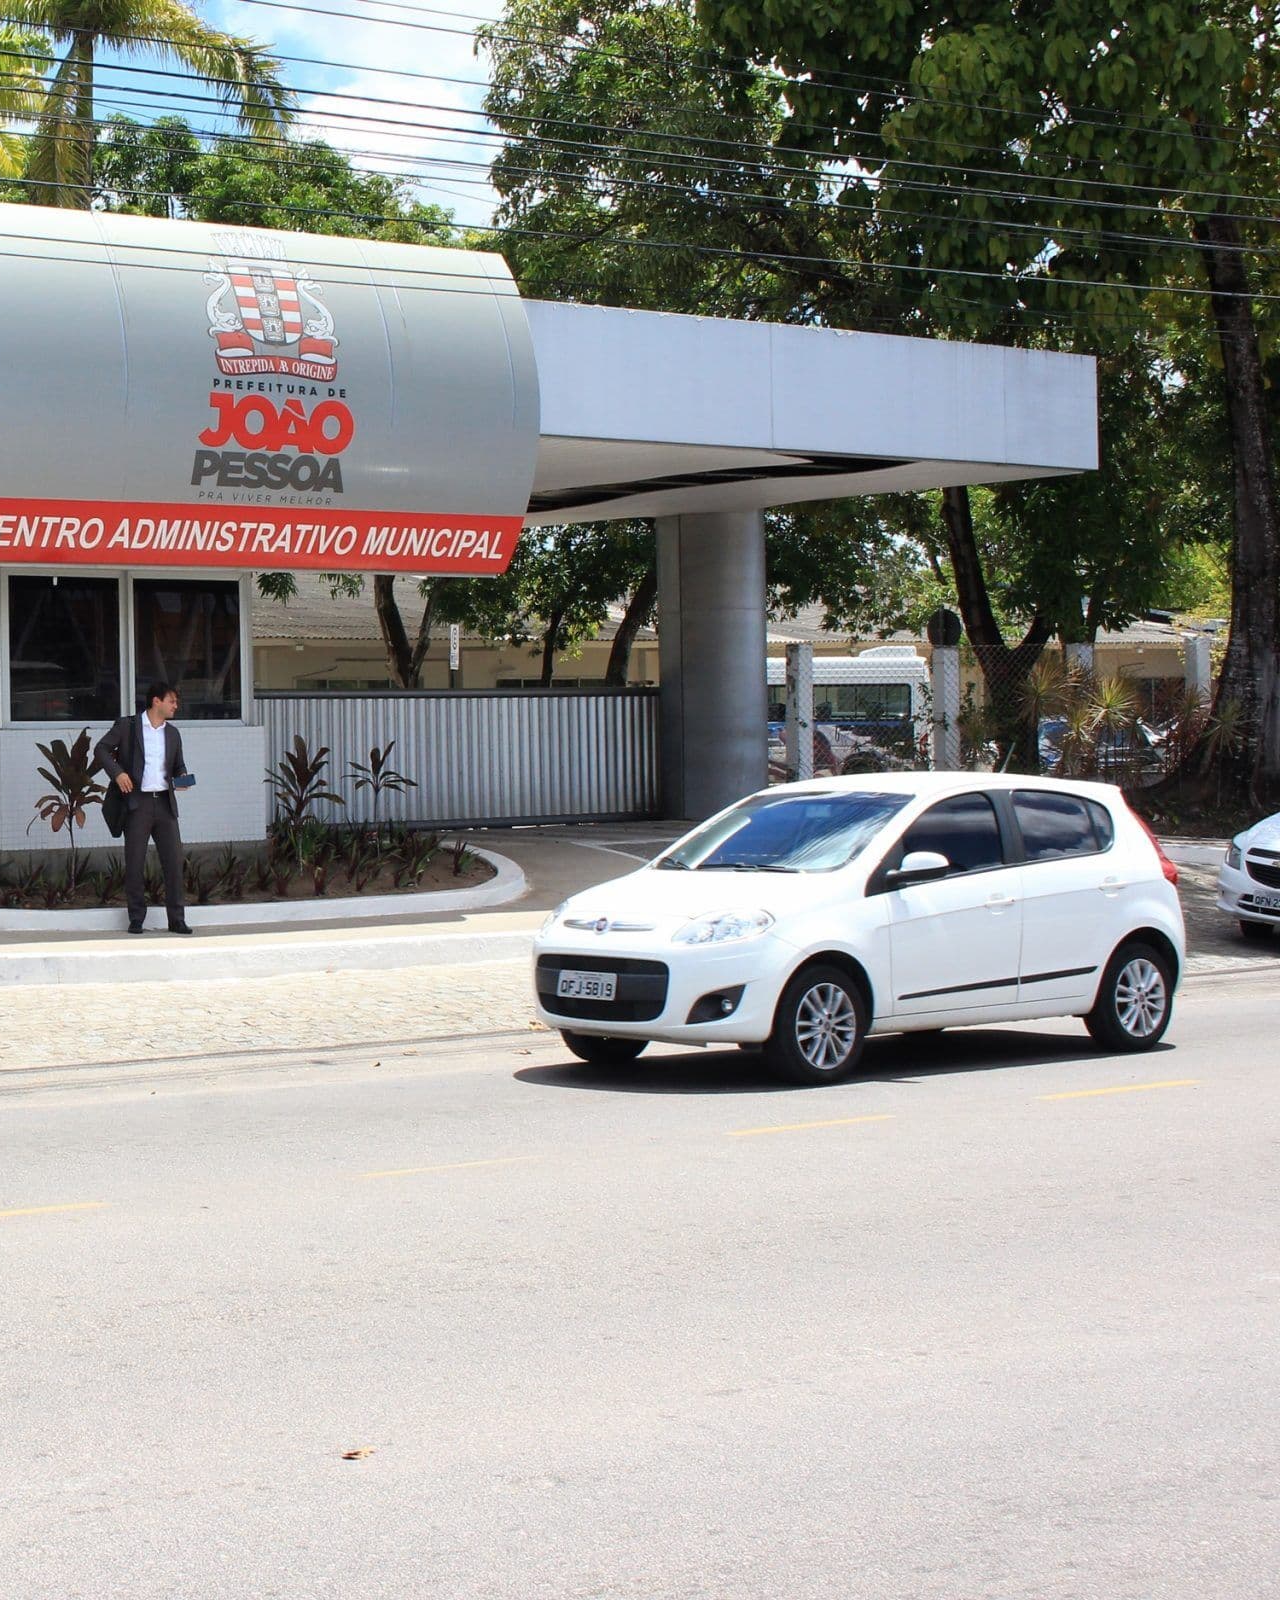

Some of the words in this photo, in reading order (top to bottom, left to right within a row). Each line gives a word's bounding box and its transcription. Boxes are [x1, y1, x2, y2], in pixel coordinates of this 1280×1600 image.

[220, 358, 275, 373] INTREPIDA
[291, 361, 334, 380] ORIGINE
[213, 378, 318, 396] PREFEITURA
[327, 388, 347, 398] DE
[198, 391, 355, 455] JOÃO
[190, 449, 344, 494] PESSOA
[198, 491, 224, 501] PRA
[232, 493, 272, 504] VIVER
[279, 496, 333, 506] MELHOR
[107, 517, 358, 556] ADMINISTRATIVO
[361, 526, 503, 560] MUNICIPAL
